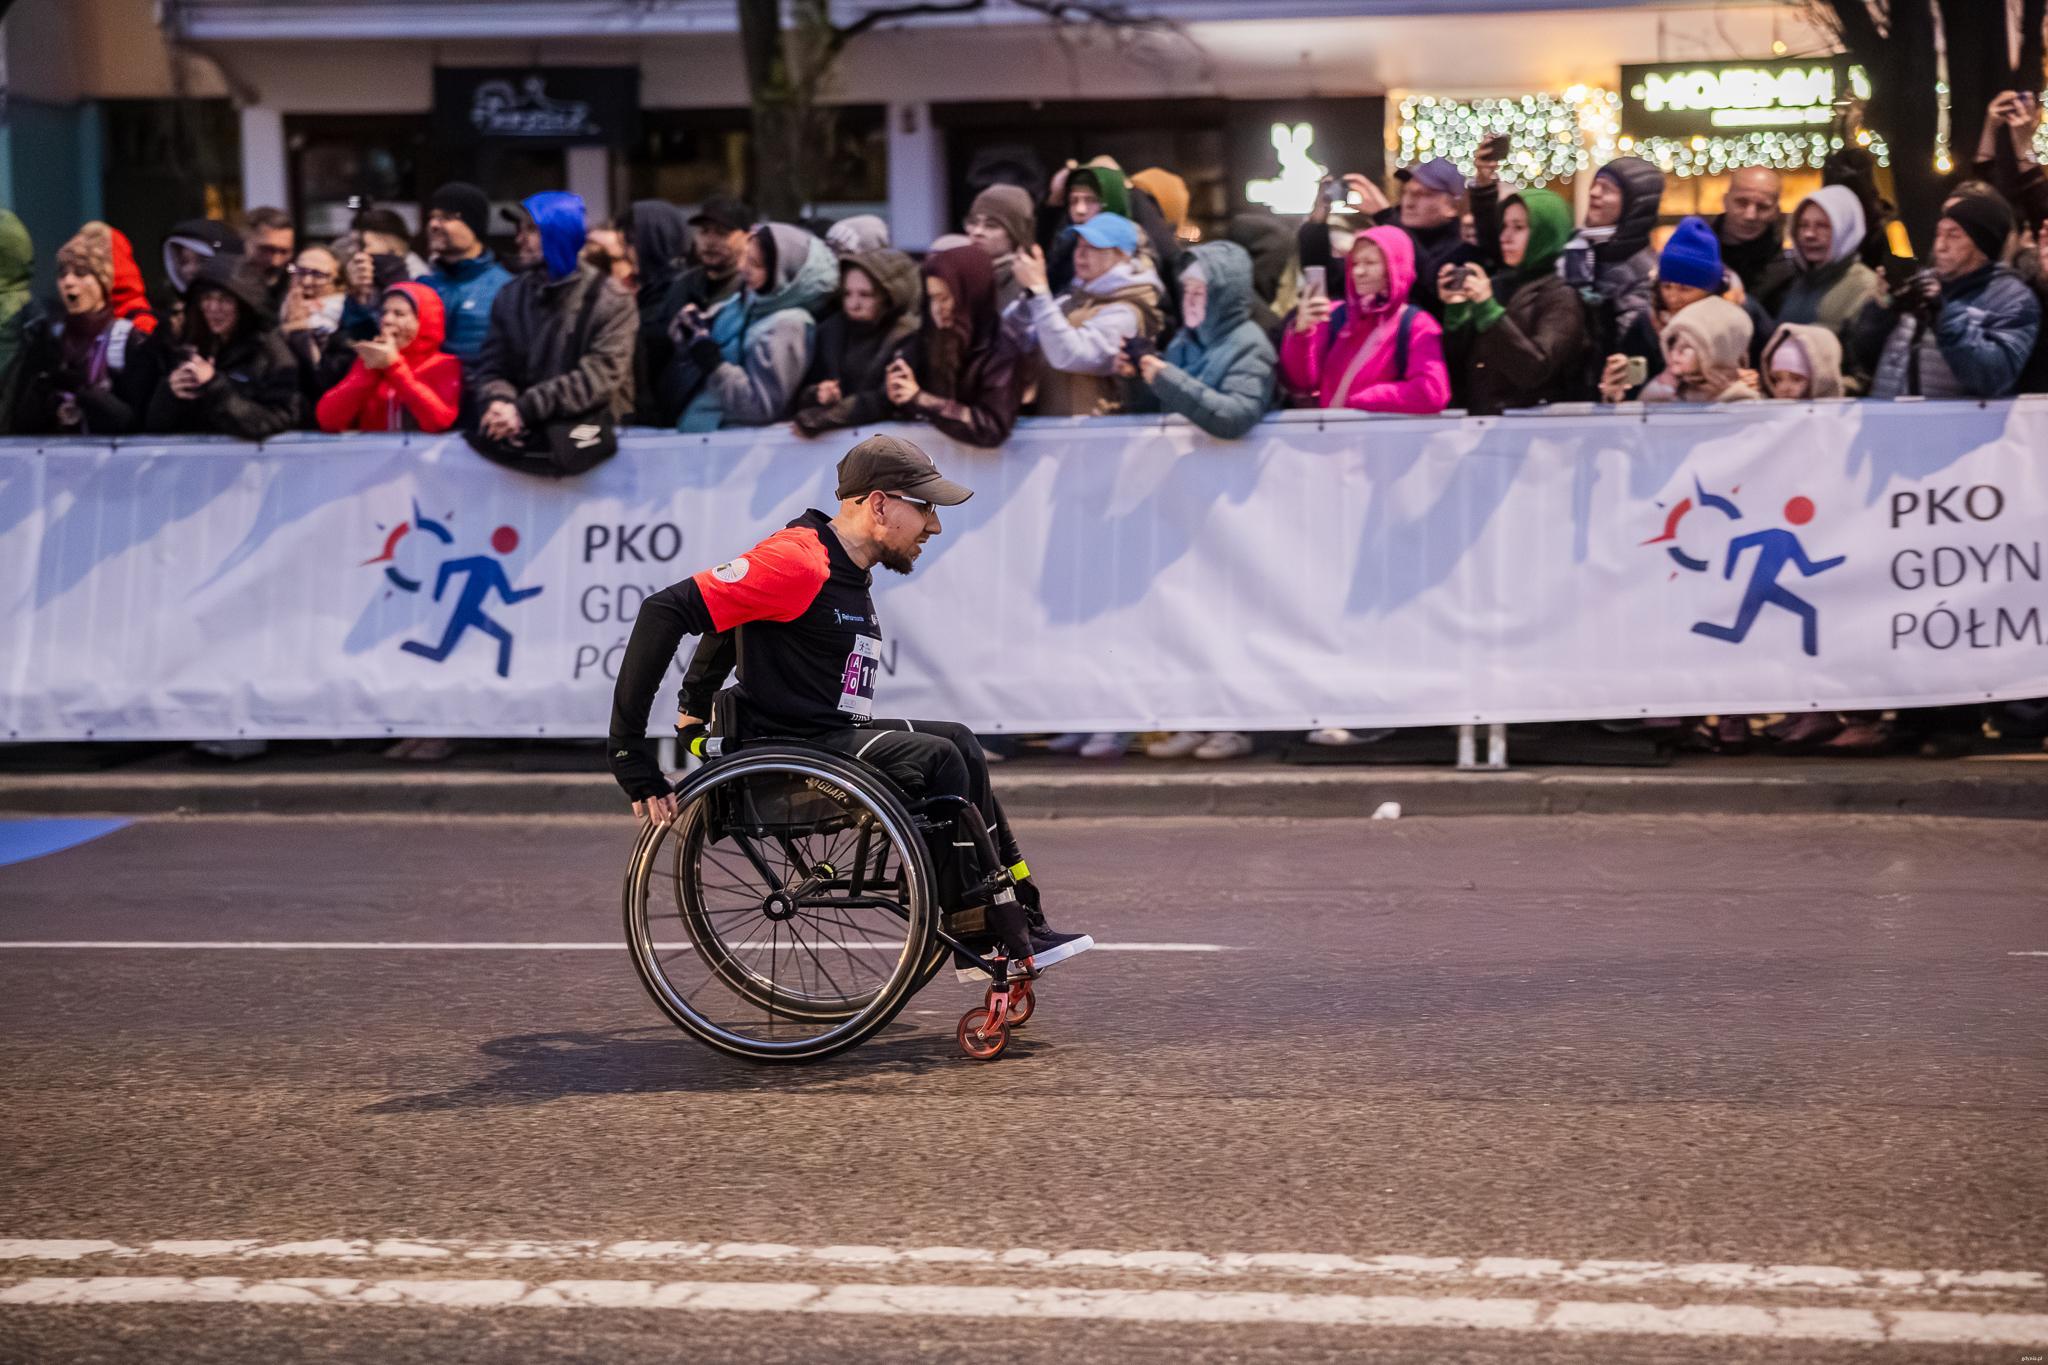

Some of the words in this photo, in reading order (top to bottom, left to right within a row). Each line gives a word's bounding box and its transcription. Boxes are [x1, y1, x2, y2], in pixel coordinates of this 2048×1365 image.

[1890, 484, 2005, 528] PKO
[583, 522, 682, 563] PKO
[1890, 541, 2041, 590] GDYN
[1891, 600, 2048, 650] PÓŁM
[853, 656, 860, 668] A
